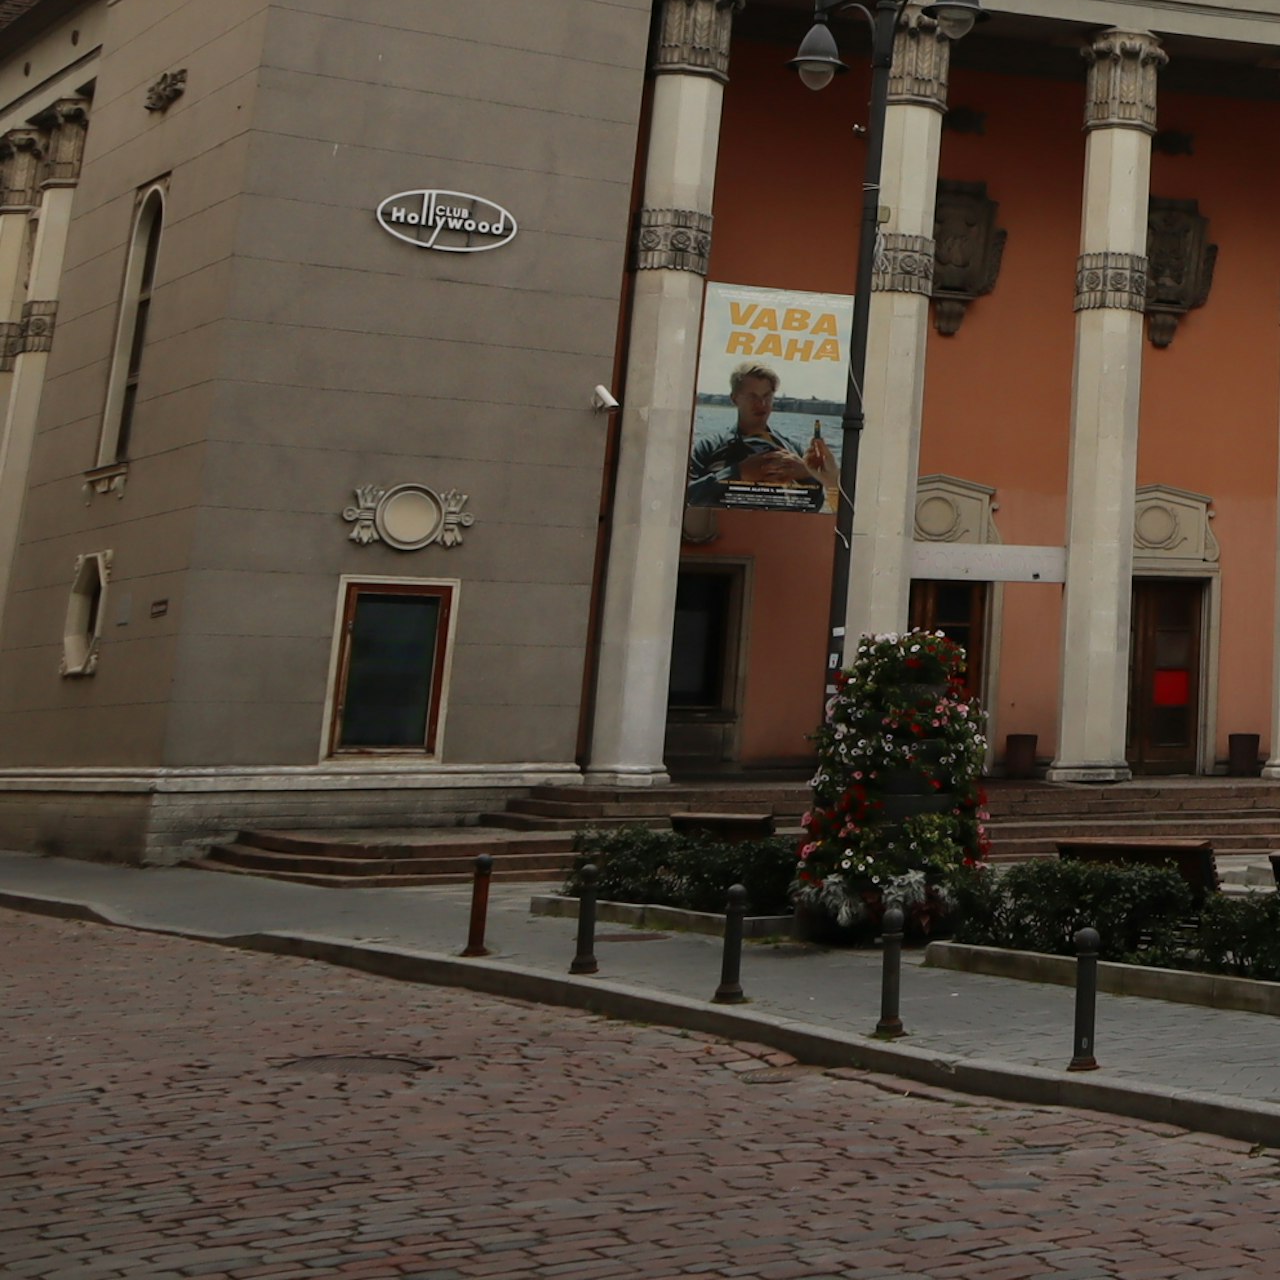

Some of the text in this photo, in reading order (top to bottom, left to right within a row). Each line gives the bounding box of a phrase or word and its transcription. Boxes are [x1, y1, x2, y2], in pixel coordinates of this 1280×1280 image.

[391, 192, 505, 247] Hollywood
[435, 205, 469, 219] CLUB
[728, 301, 838, 337] VABA
[725, 331, 841, 362] RAHA
